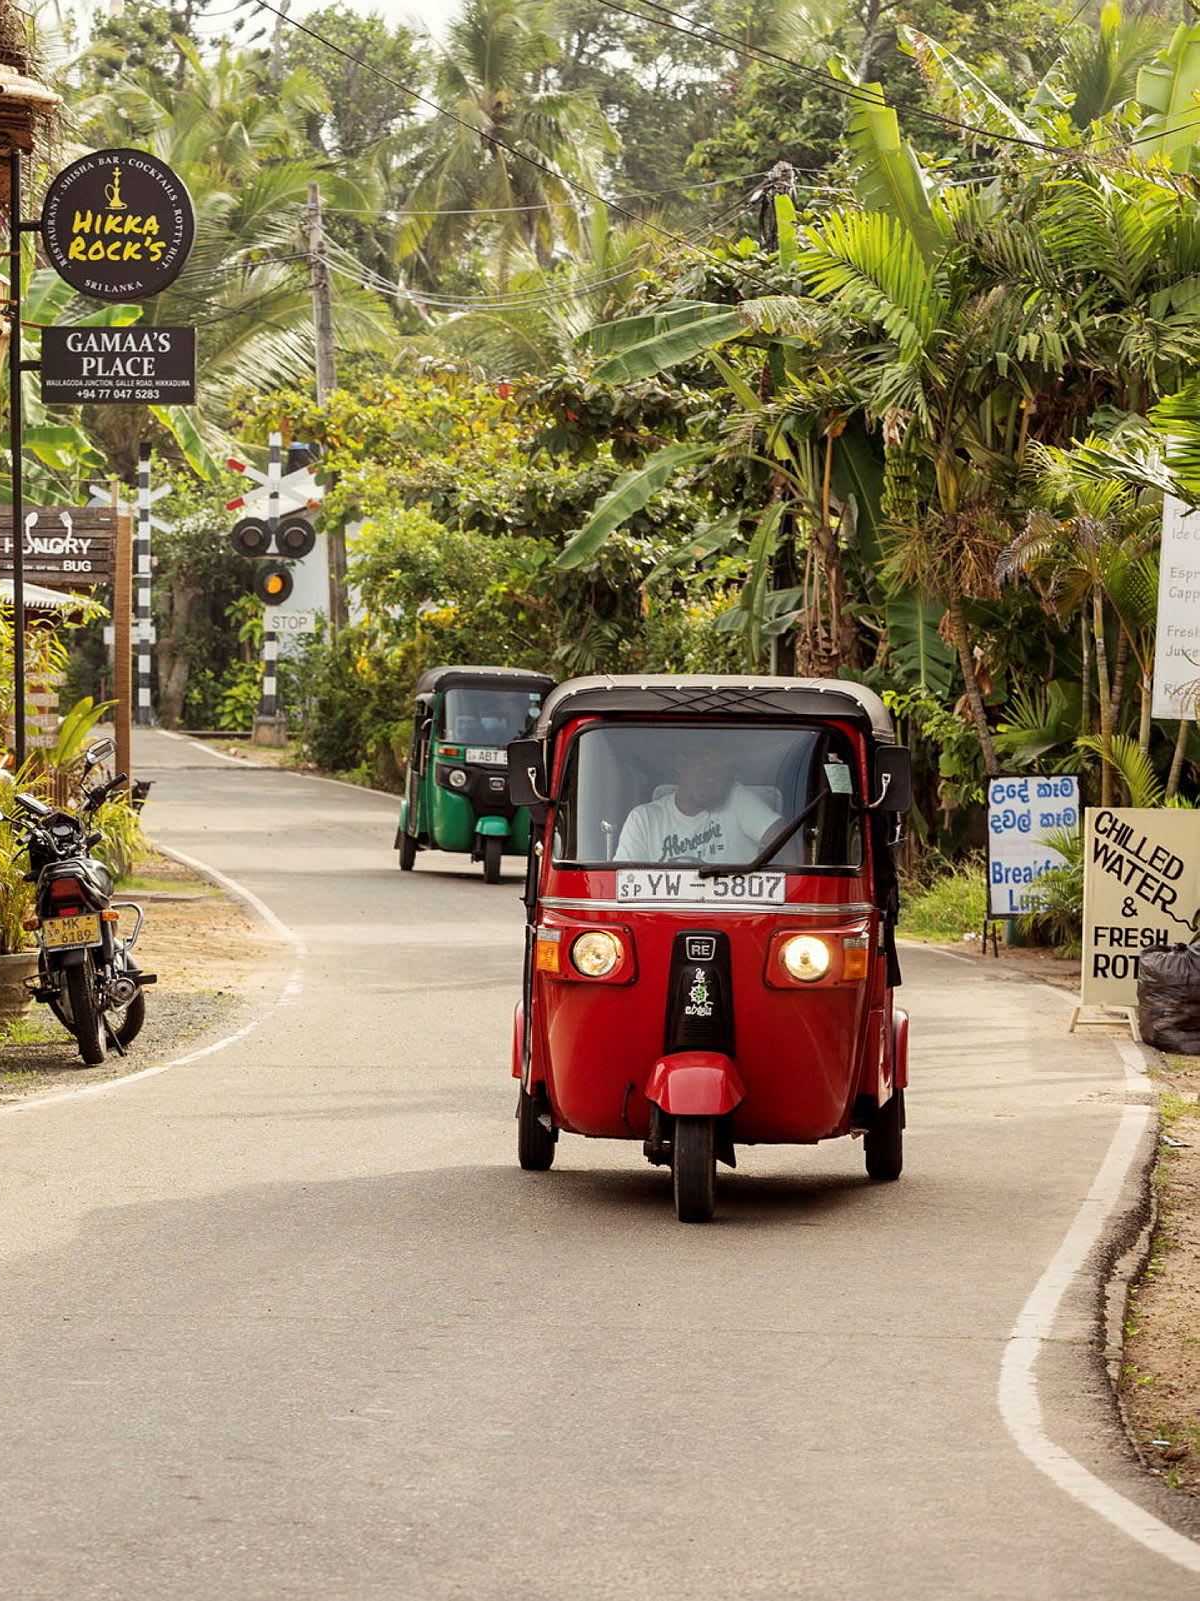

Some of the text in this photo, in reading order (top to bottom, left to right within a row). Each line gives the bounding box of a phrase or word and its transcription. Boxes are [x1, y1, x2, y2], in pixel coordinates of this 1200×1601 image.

[47, 156, 184, 270] RESTAURANT SHISHA BAR COCKTAILS ROTTY HUT
[72, 209, 160, 235] HIKKA
[68, 236, 166, 261] ROCK'S
[84, 279, 144, 293] SRI LANKA
[66, 332, 172, 353] GAMAA'S
[81, 357, 155, 377] PLACE
[115, 379, 134, 387] GALLE
[76, 389, 160, 400] +94 77 047 5283
[63, 560, 92, 572] BUG
[272, 615, 308, 629] STOP
[480, 751, 498, 761] ABT
[991, 779, 1030, 804] උදේ
[1094, 811, 1184, 881] CHILLED
[1093, 837, 1179, 913] WATER
[621, 884, 641, 897] SP
[648, 874, 681, 896] YW
[713, 875, 782, 898] 5807
[1121, 896, 1138, 917] &
[62, 918, 79, 930] MK
[1094, 926, 1168, 948] FRESH
[691, 945, 710, 956] RE
